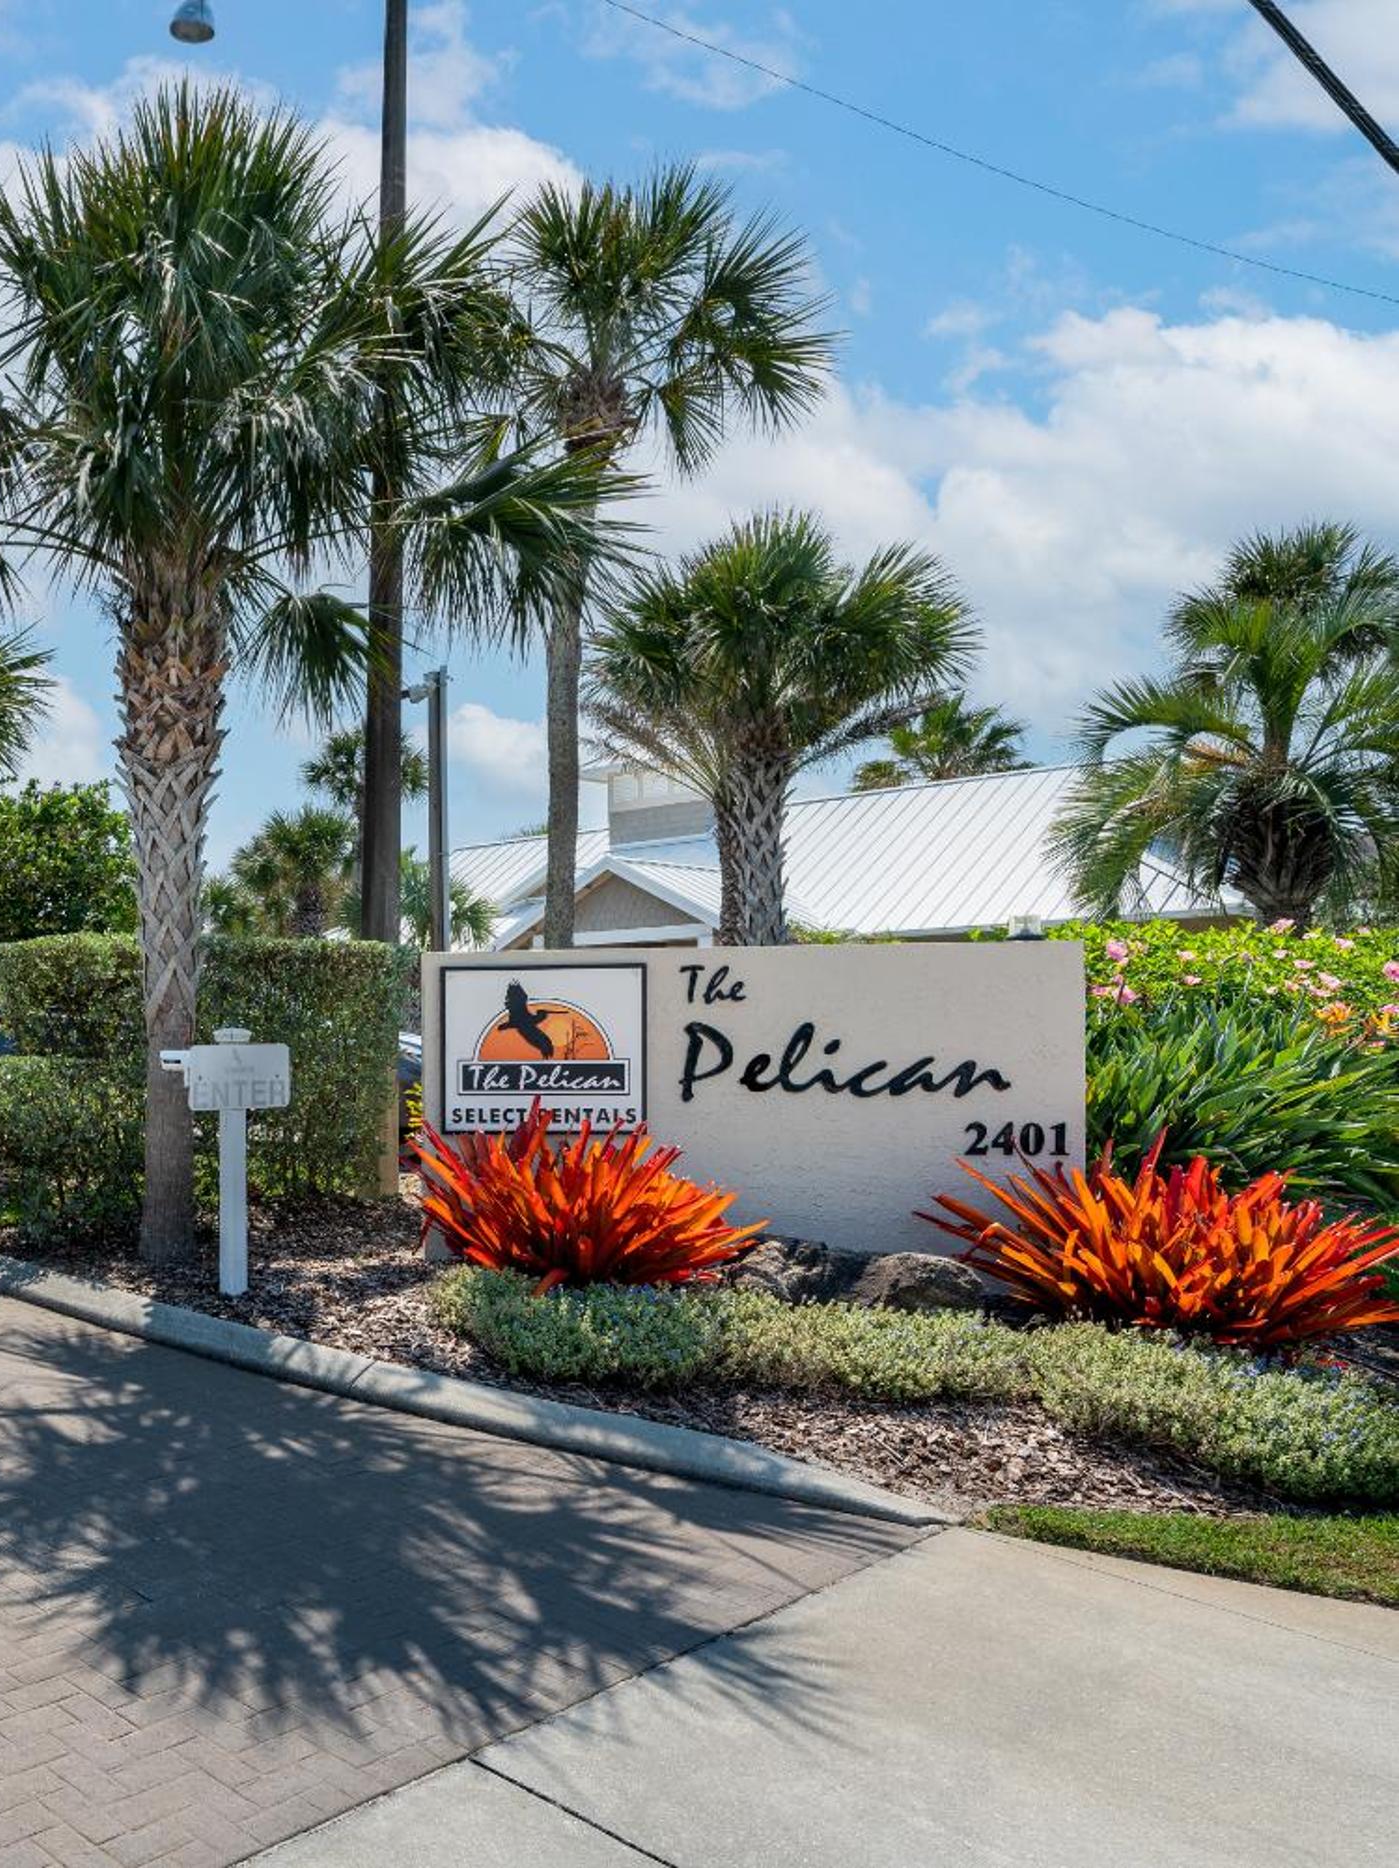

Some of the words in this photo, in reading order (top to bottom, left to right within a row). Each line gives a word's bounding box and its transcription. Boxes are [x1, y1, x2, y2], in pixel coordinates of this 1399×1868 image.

[679, 964, 747, 1004] The
[468, 1065, 511, 1090] The
[519, 1064, 622, 1091] Pelican
[678, 1021, 1012, 1102] Pelican
[193, 1079, 285, 1109] ENTER
[452, 1107, 527, 1123] SELECT
[964, 1121, 1070, 1156] 2401
